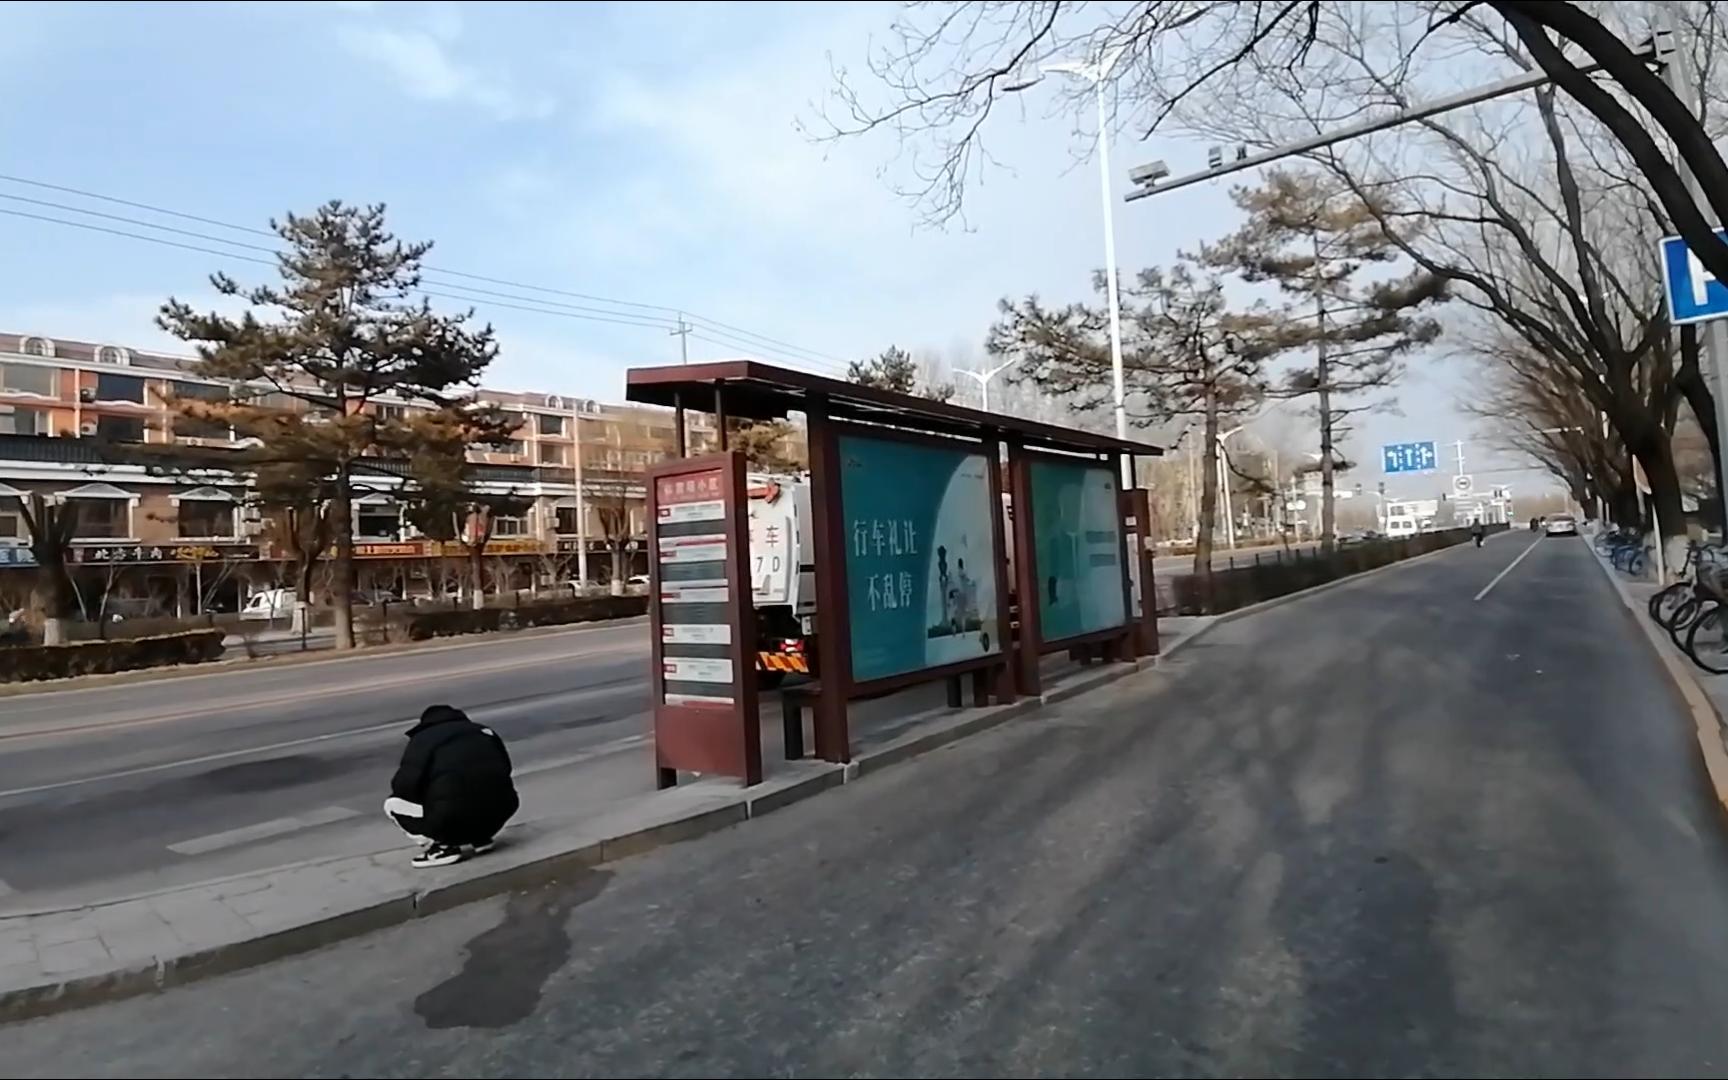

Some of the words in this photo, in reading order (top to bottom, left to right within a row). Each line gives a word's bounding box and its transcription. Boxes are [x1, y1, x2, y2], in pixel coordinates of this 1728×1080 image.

[853, 519, 918, 557] 行车礼让
[867, 571, 913, 612] 不乱停
